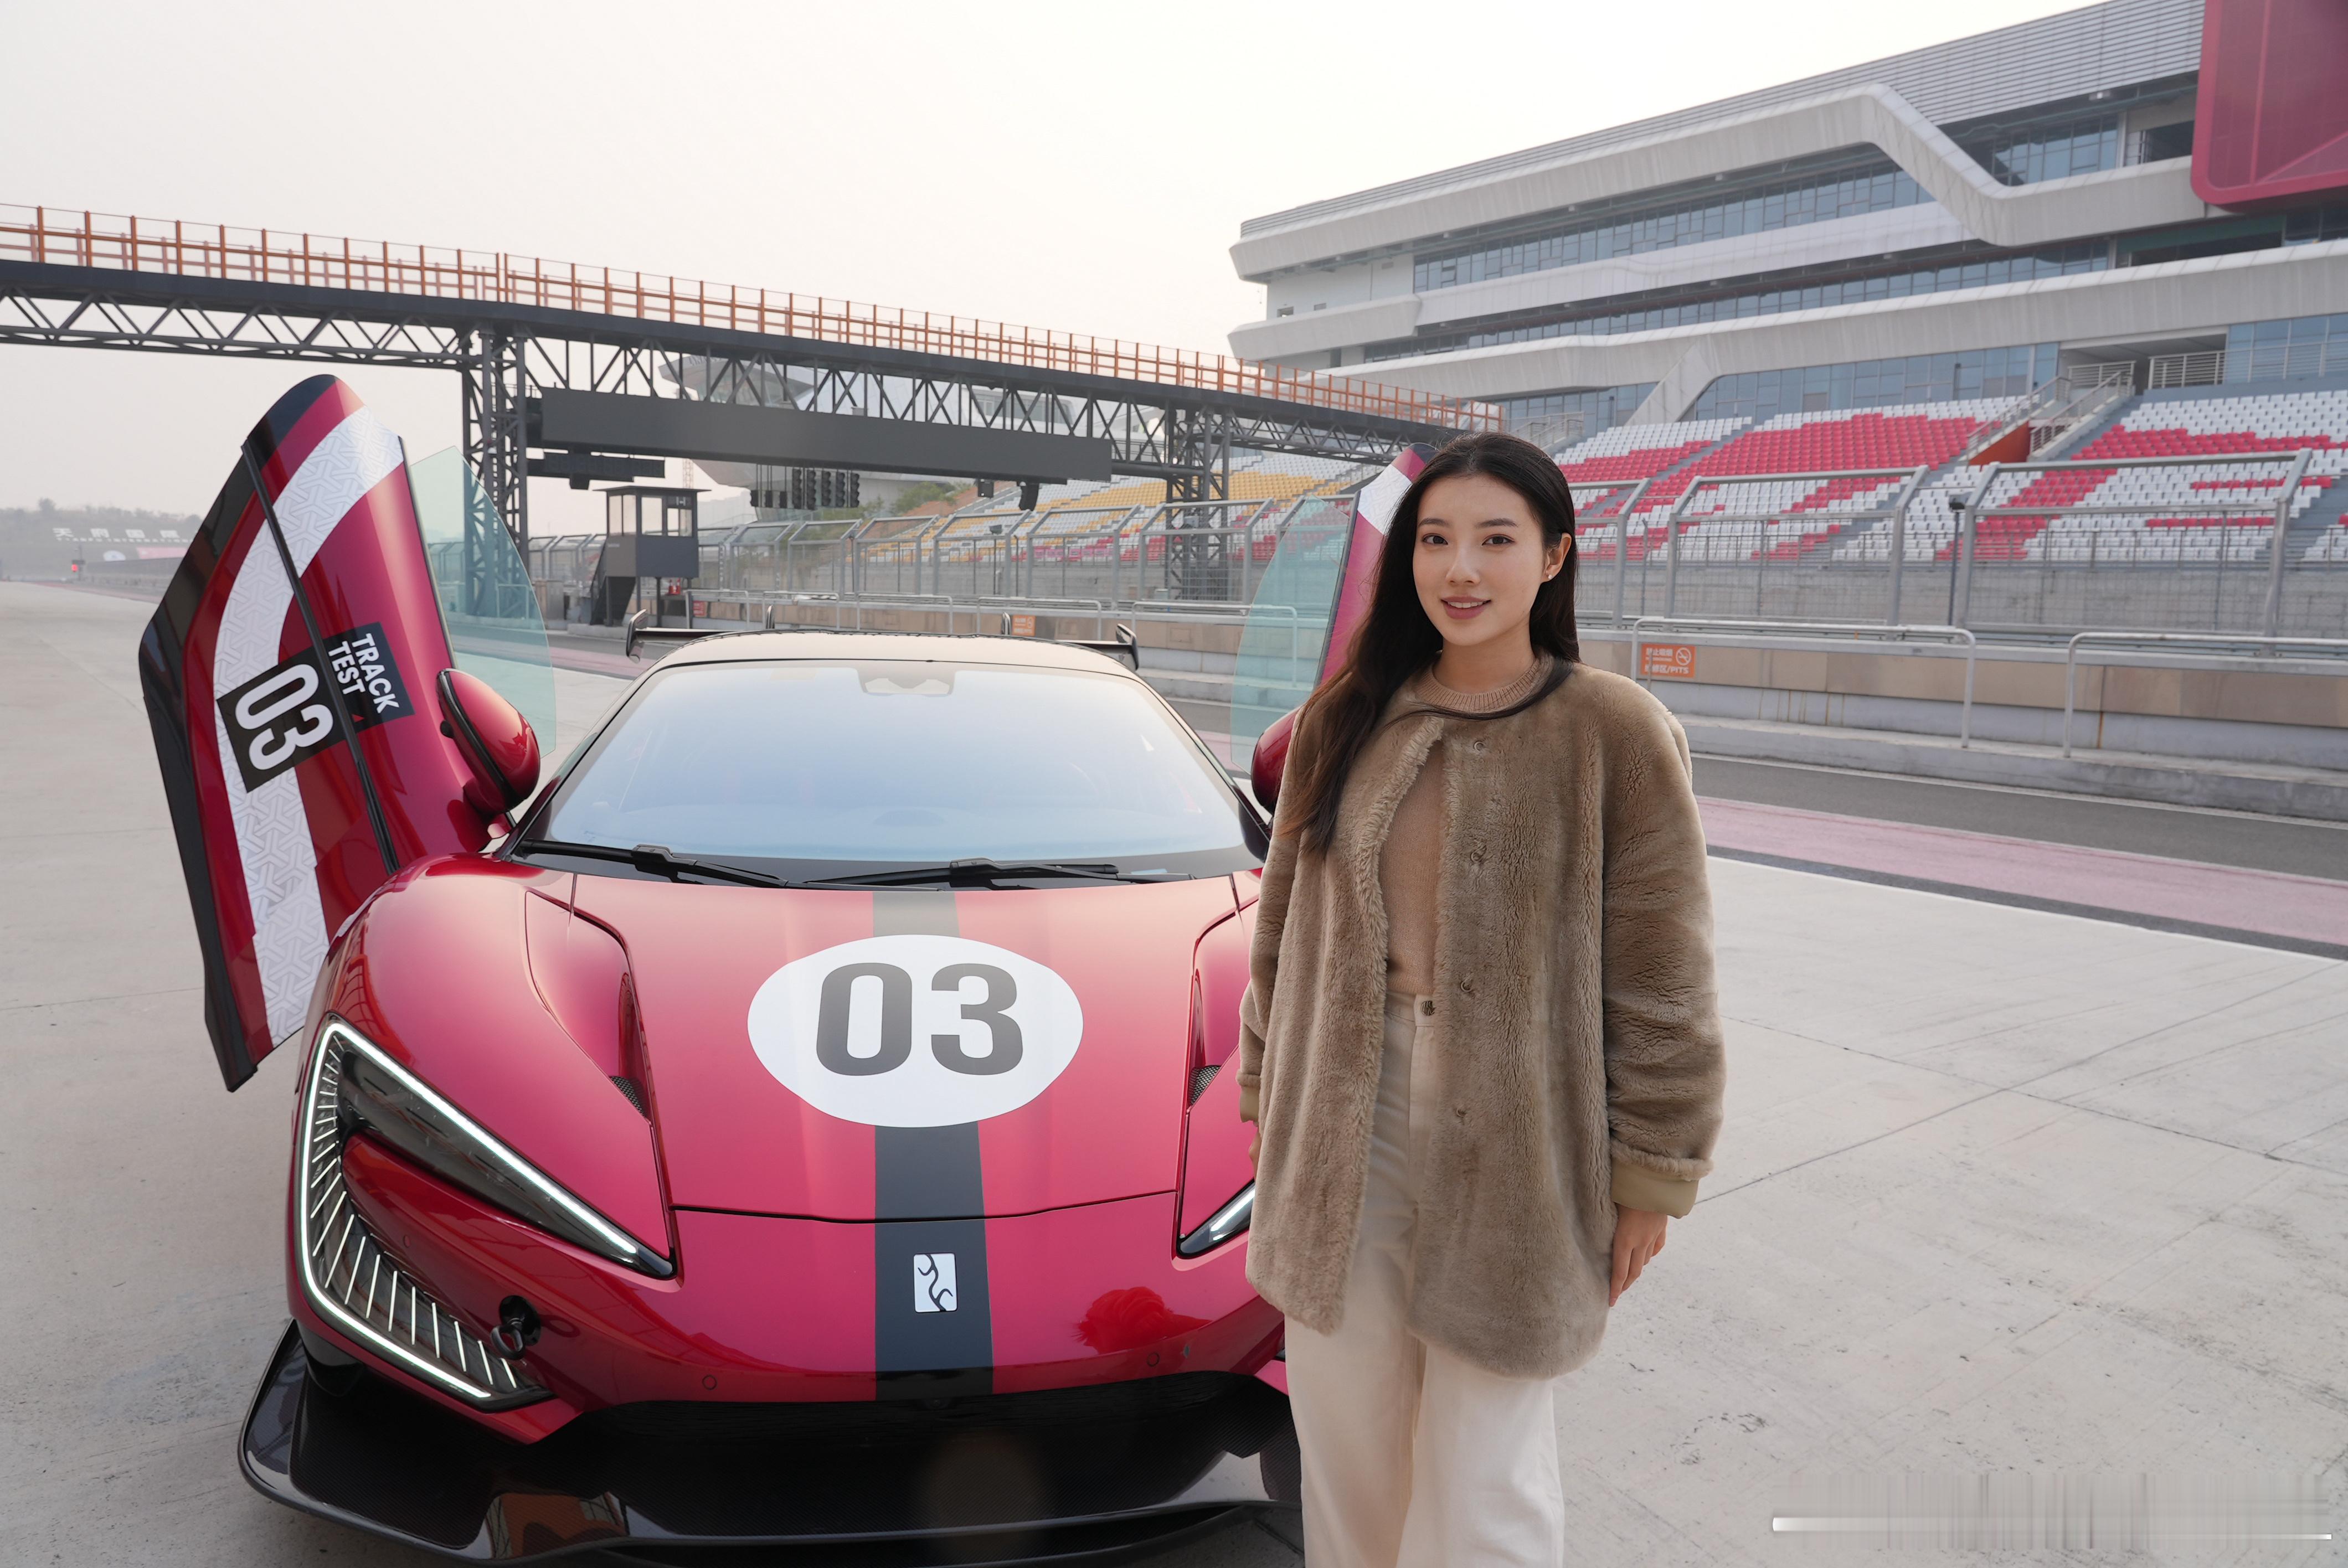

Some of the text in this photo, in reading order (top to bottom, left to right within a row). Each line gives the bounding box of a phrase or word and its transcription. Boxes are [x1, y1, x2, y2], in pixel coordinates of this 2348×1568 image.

[328, 641, 366, 694] TEST
[352, 633, 400, 714] TRACK
[235, 664, 333, 770] 03
[816, 962, 1023, 1076] 03
